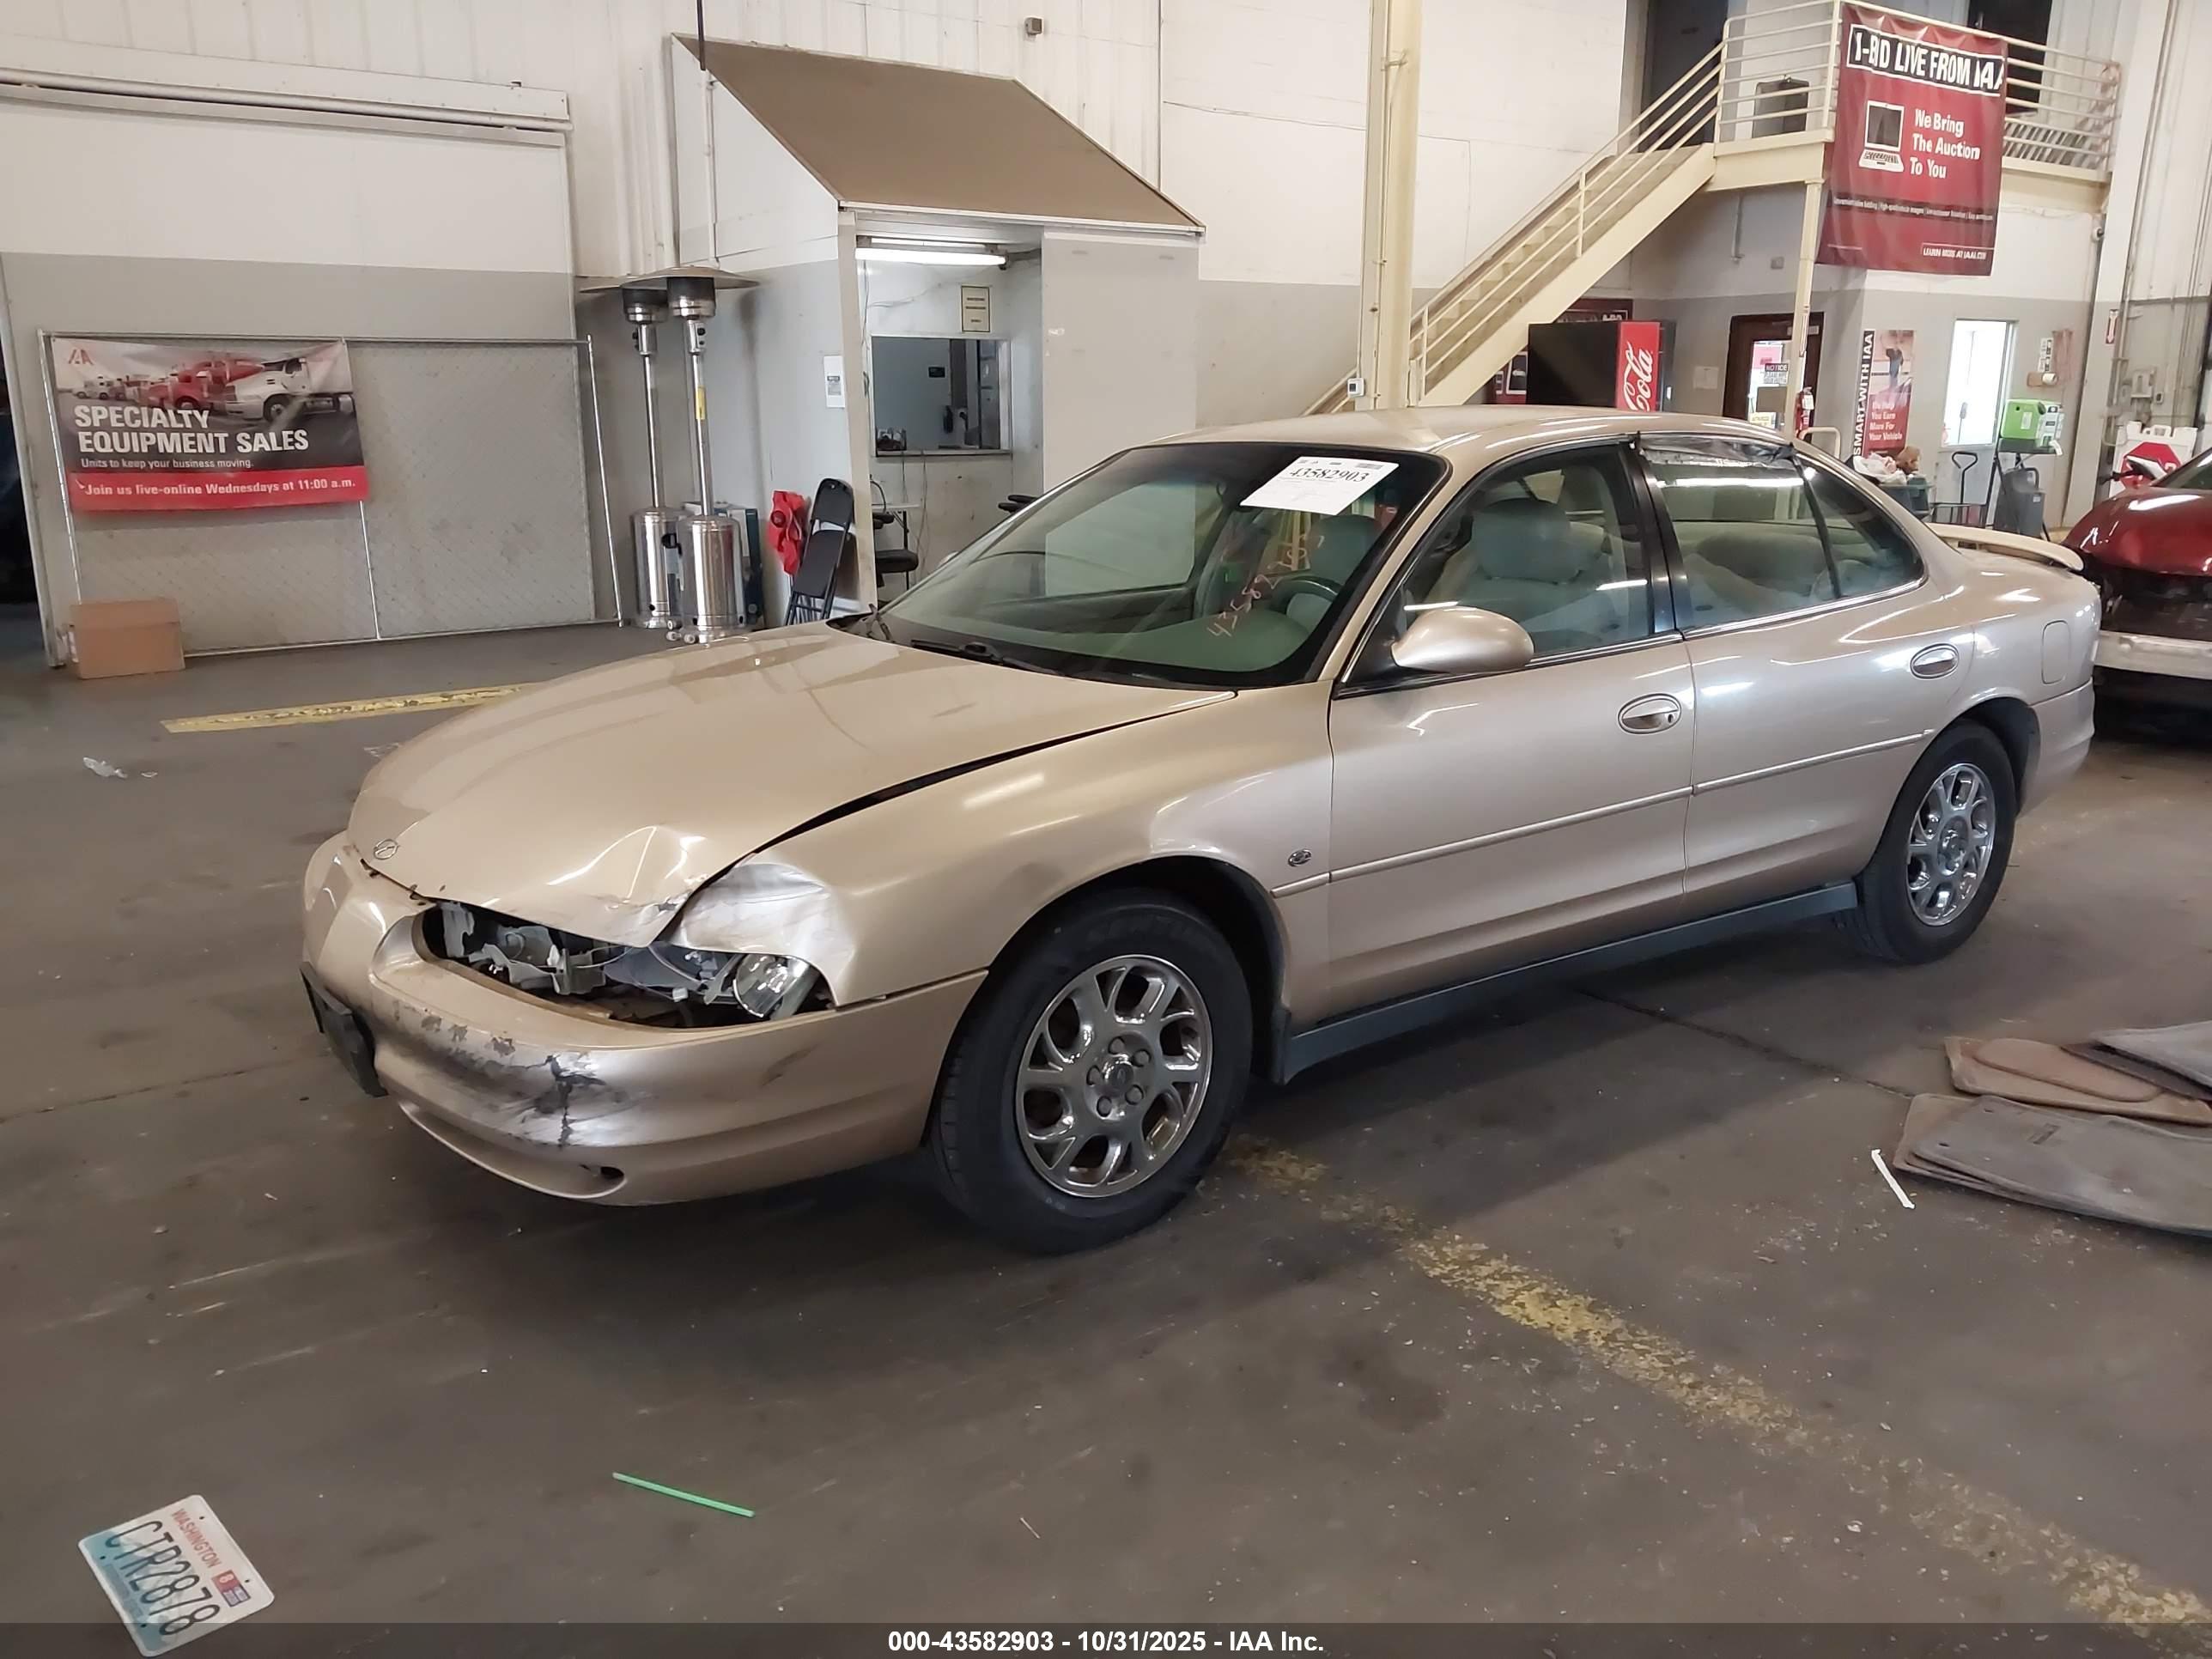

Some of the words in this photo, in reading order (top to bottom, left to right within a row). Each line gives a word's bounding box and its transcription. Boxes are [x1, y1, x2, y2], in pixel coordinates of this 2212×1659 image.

[1894, 43, 1929, 76] LIVE
[1929, 51, 1972, 86] FROM
[1915, 108, 1932, 129] We
[1933, 112, 1965, 138] Bring
[1912, 133, 1933, 153] The
[1935, 137, 1981, 161] Auction
[1910, 156, 1923, 175] To
[1927, 159, 1948, 179] You
[1863, 333, 1874, 360] IAA
[1858, 363, 1870, 402] WITH
[74, 404, 210, 429] SPECIALTY
[1852, 404, 1866, 455] SMART
[78, 431, 229, 454] EQUIPMENT
[236, 429, 310, 453] SALES
[81, 458, 108, 469] Units
[109, 459, 119, 469] to
[122, 459, 146, 470] keep
[149, 459, 170, 471] your
[173, 459, 215, 469] business
[1290, 468, 1370, 482] 43582903
[85, 483, 113, 495] Join
[117, 485, 132, 495] us
[136, 483, 203, 495] live-online
[205, 482, 280, 495] Wednesdays
[282, 481, 295, 491] at
[298, 478, 328, 490] 11:00
[331, 479, 356, 489] a.m.
[173, 1507, 222, 1569] WASHINGTON
[105, 1520, 221, 1636] CTR2878
